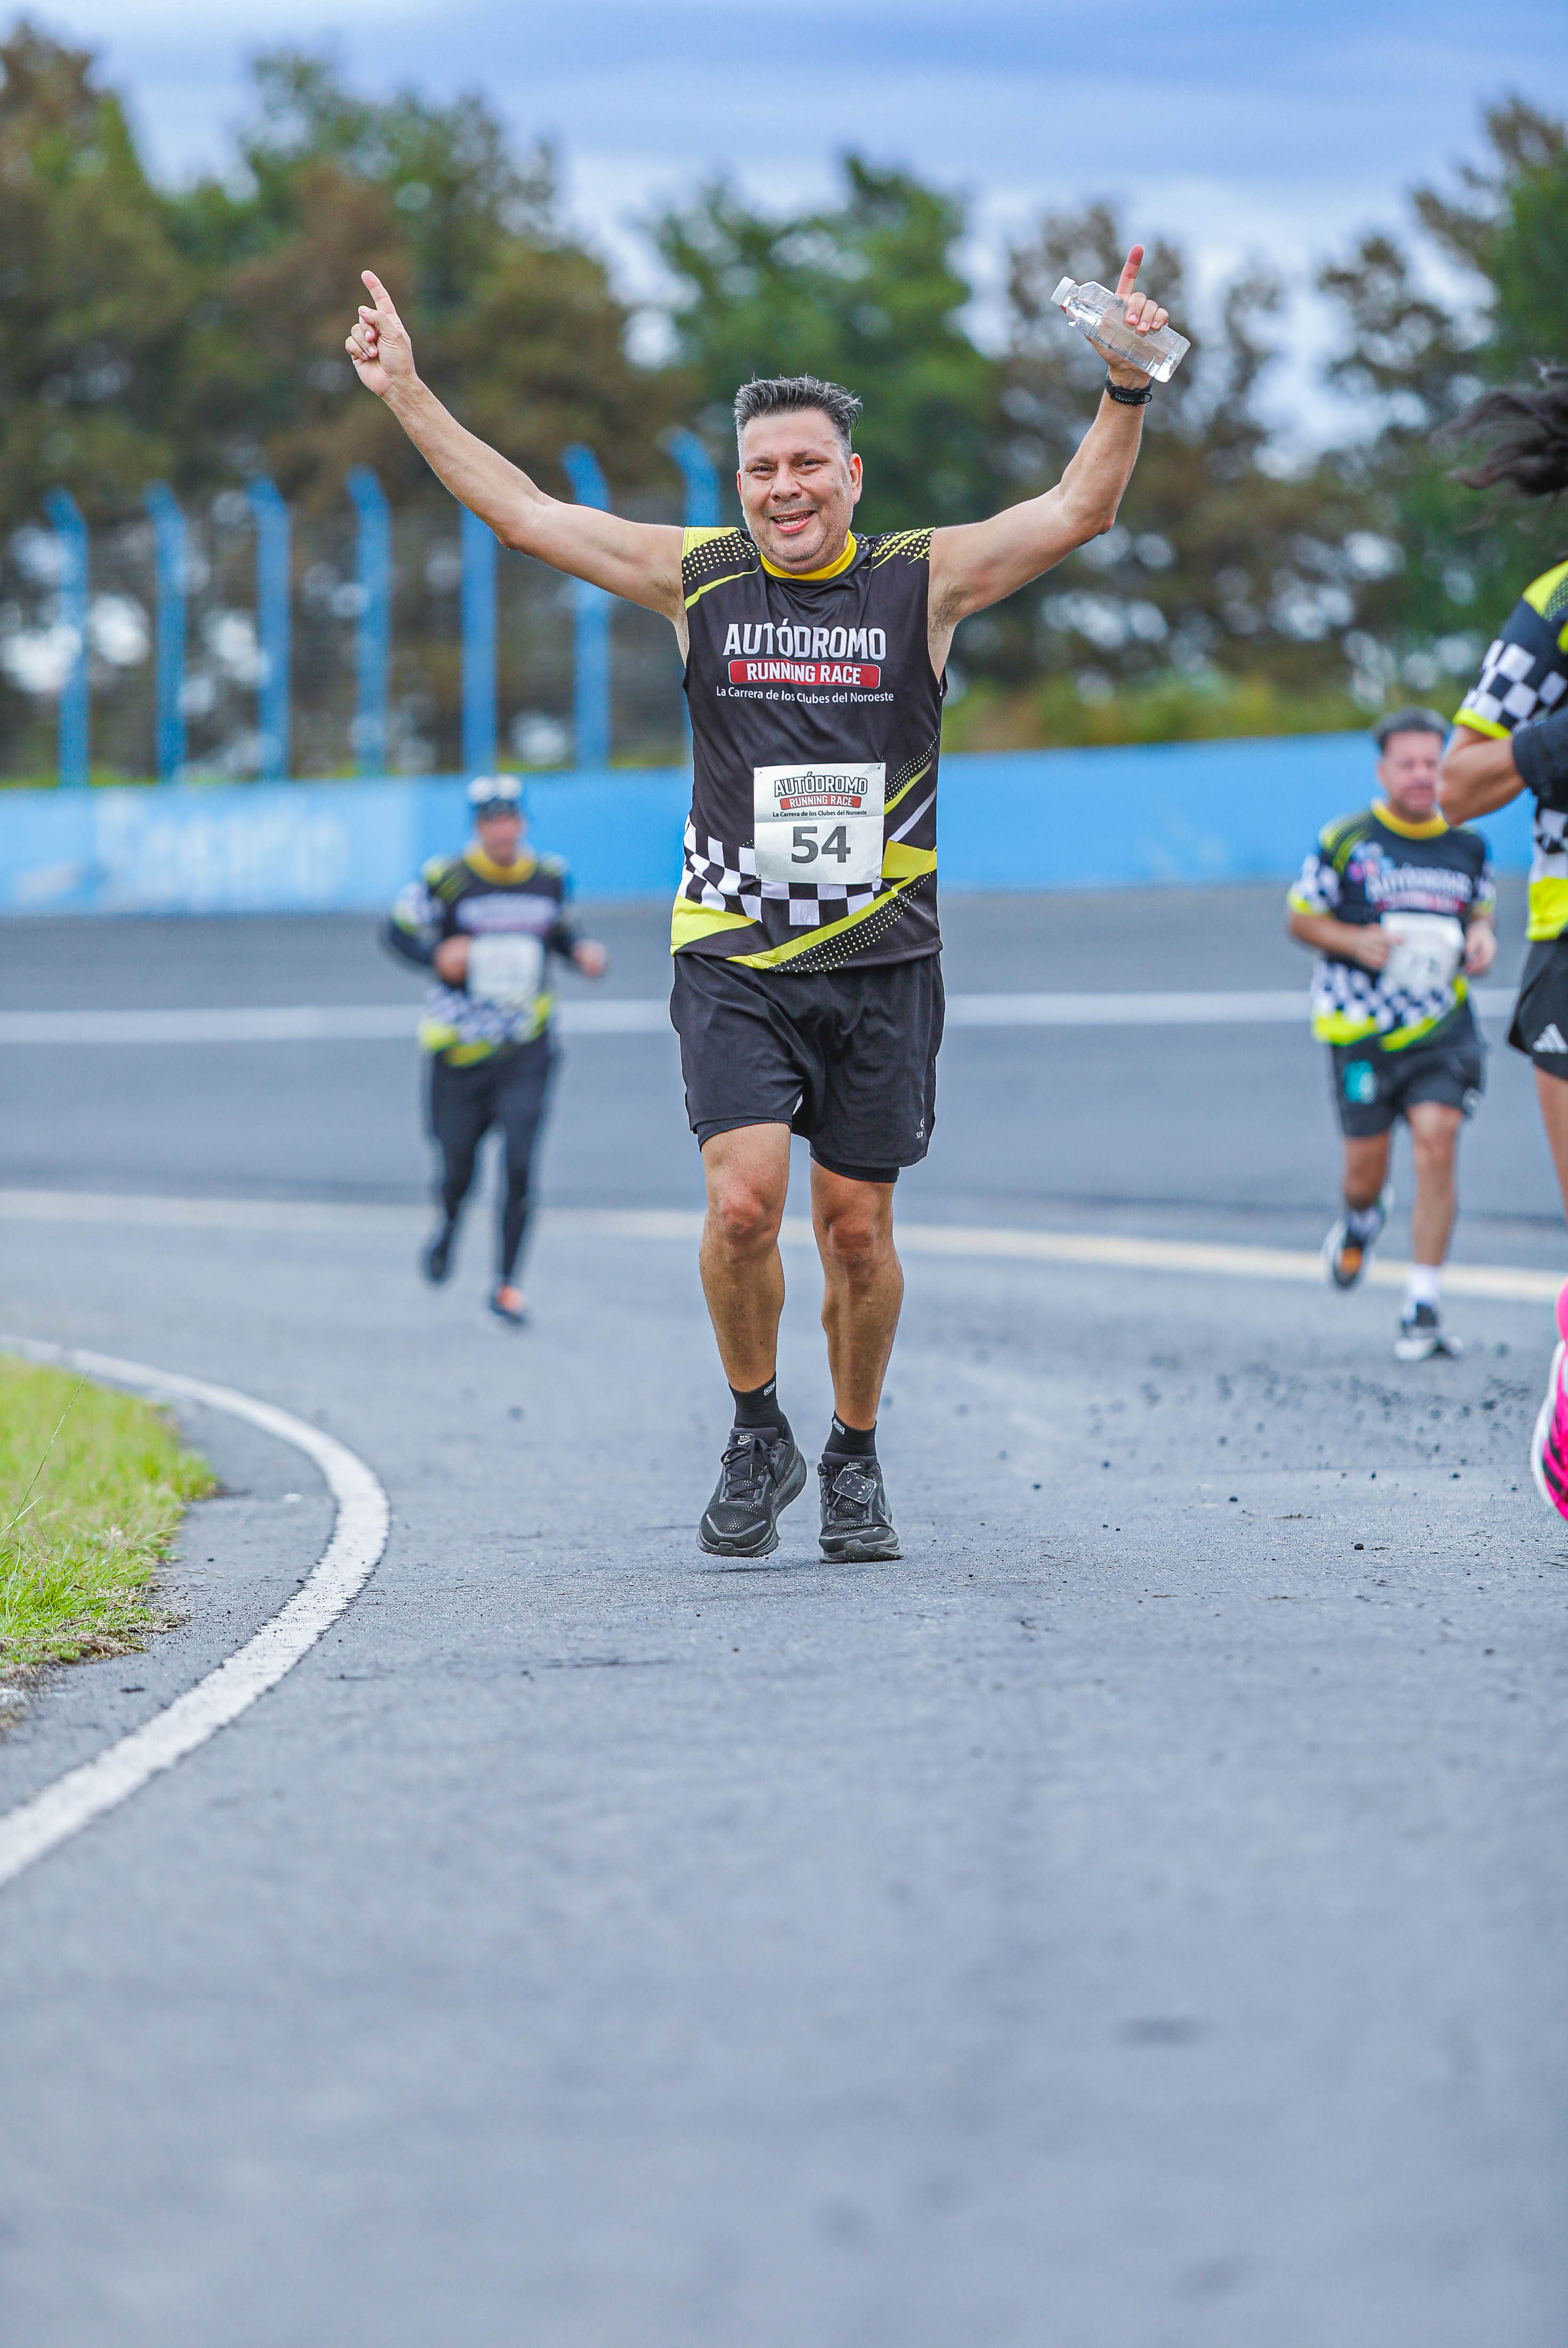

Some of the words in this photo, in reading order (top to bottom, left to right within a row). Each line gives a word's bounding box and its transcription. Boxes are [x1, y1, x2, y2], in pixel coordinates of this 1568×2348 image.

[722, 618, 887, 661] AUTÓDROMO
[746, 662, 816, 683] RUNNING
[820, 666, 862, 685] RACE
[717, 686, 726, 697] La
[728, 687, 763, 700] Carrera
[766, 689, 778, 701] de
[781, 689, 795, 702] los
[797, 692, 830, 704] Clubes
[832, 692, 848, 703] del
[850, 692, 894, 703] Noroeste
[774, 771, 868, 797] AUTÓDROMO
[789, 795, 828, 808] RUNNING
[830, 795, 852, 807] RACE
[791, 826, 851, 864] 54
